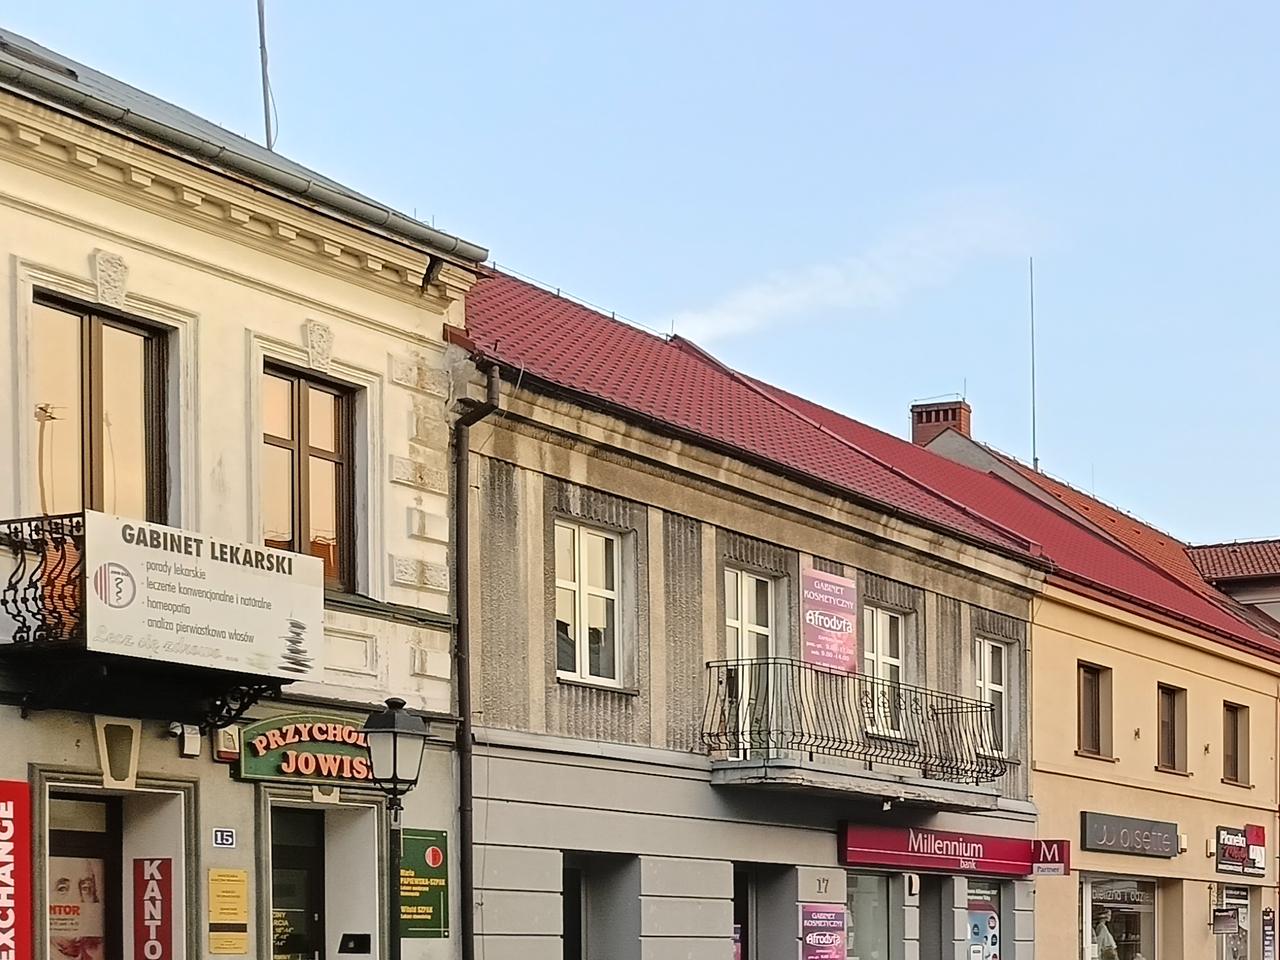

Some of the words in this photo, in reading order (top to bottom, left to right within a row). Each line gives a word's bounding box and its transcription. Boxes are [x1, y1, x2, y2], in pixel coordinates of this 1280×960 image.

[121, 524, 203, 558] GABINET
[211, 541, 293, 575] LEKARSKI
[146, 561, 172, 577] porady
[174, 564, 206, 580] lekarskie
[146, 577, 176, 593] leczenie
[178, 581, 235, 604] konwencjonalne
[240, 595, 272, 610] naturalne
[814, 580, 845, 596] GABINET
[147, 596, 191, 615] homeopatia
[803, 589, 855, 610] KOSMETYCZNY
[147, 617, 174, 631] analiza
[175, 621, 227, 640] pierwiastkowa
[228, 631, 255, 644] włosów
[806, 610, 853, 633] Afrodyta
[92, 624, 134, 647] Lecz
[137, 633, 160, 655] się
[163, 637, 223, 659] zdrowo
[281, 751, 373, 779] JOWIS
[215, 832, 233, 844] 15
[908, 828, 984, 858] Millennium
[1039, 840, 1060, 862] M
[959, 859, 977, 870] bank
[816, 877, 829, 893] 17
[49, 904, 80, 916] NTOR
